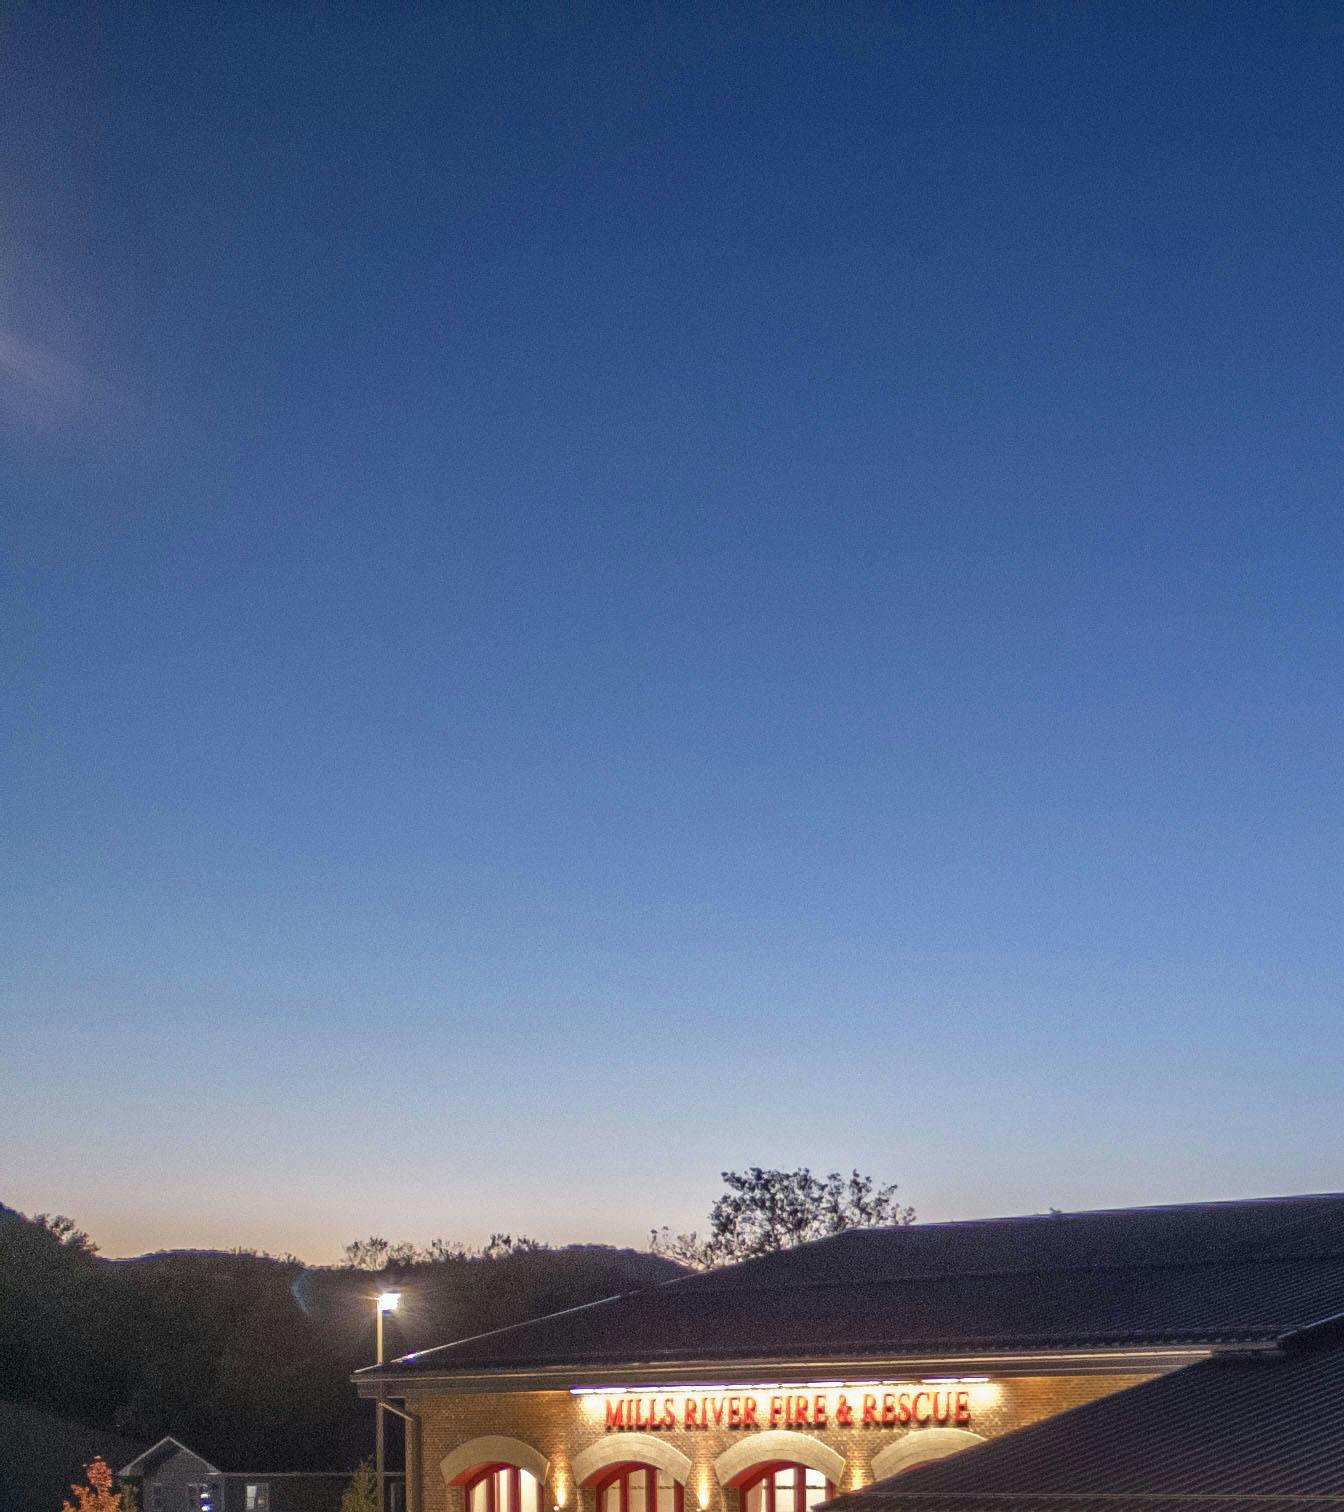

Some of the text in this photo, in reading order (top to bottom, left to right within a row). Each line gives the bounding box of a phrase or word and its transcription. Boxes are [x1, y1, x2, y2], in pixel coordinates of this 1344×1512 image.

[605, 1391, 971, 1428] MILLS RIVER FIRE & RESCUE
